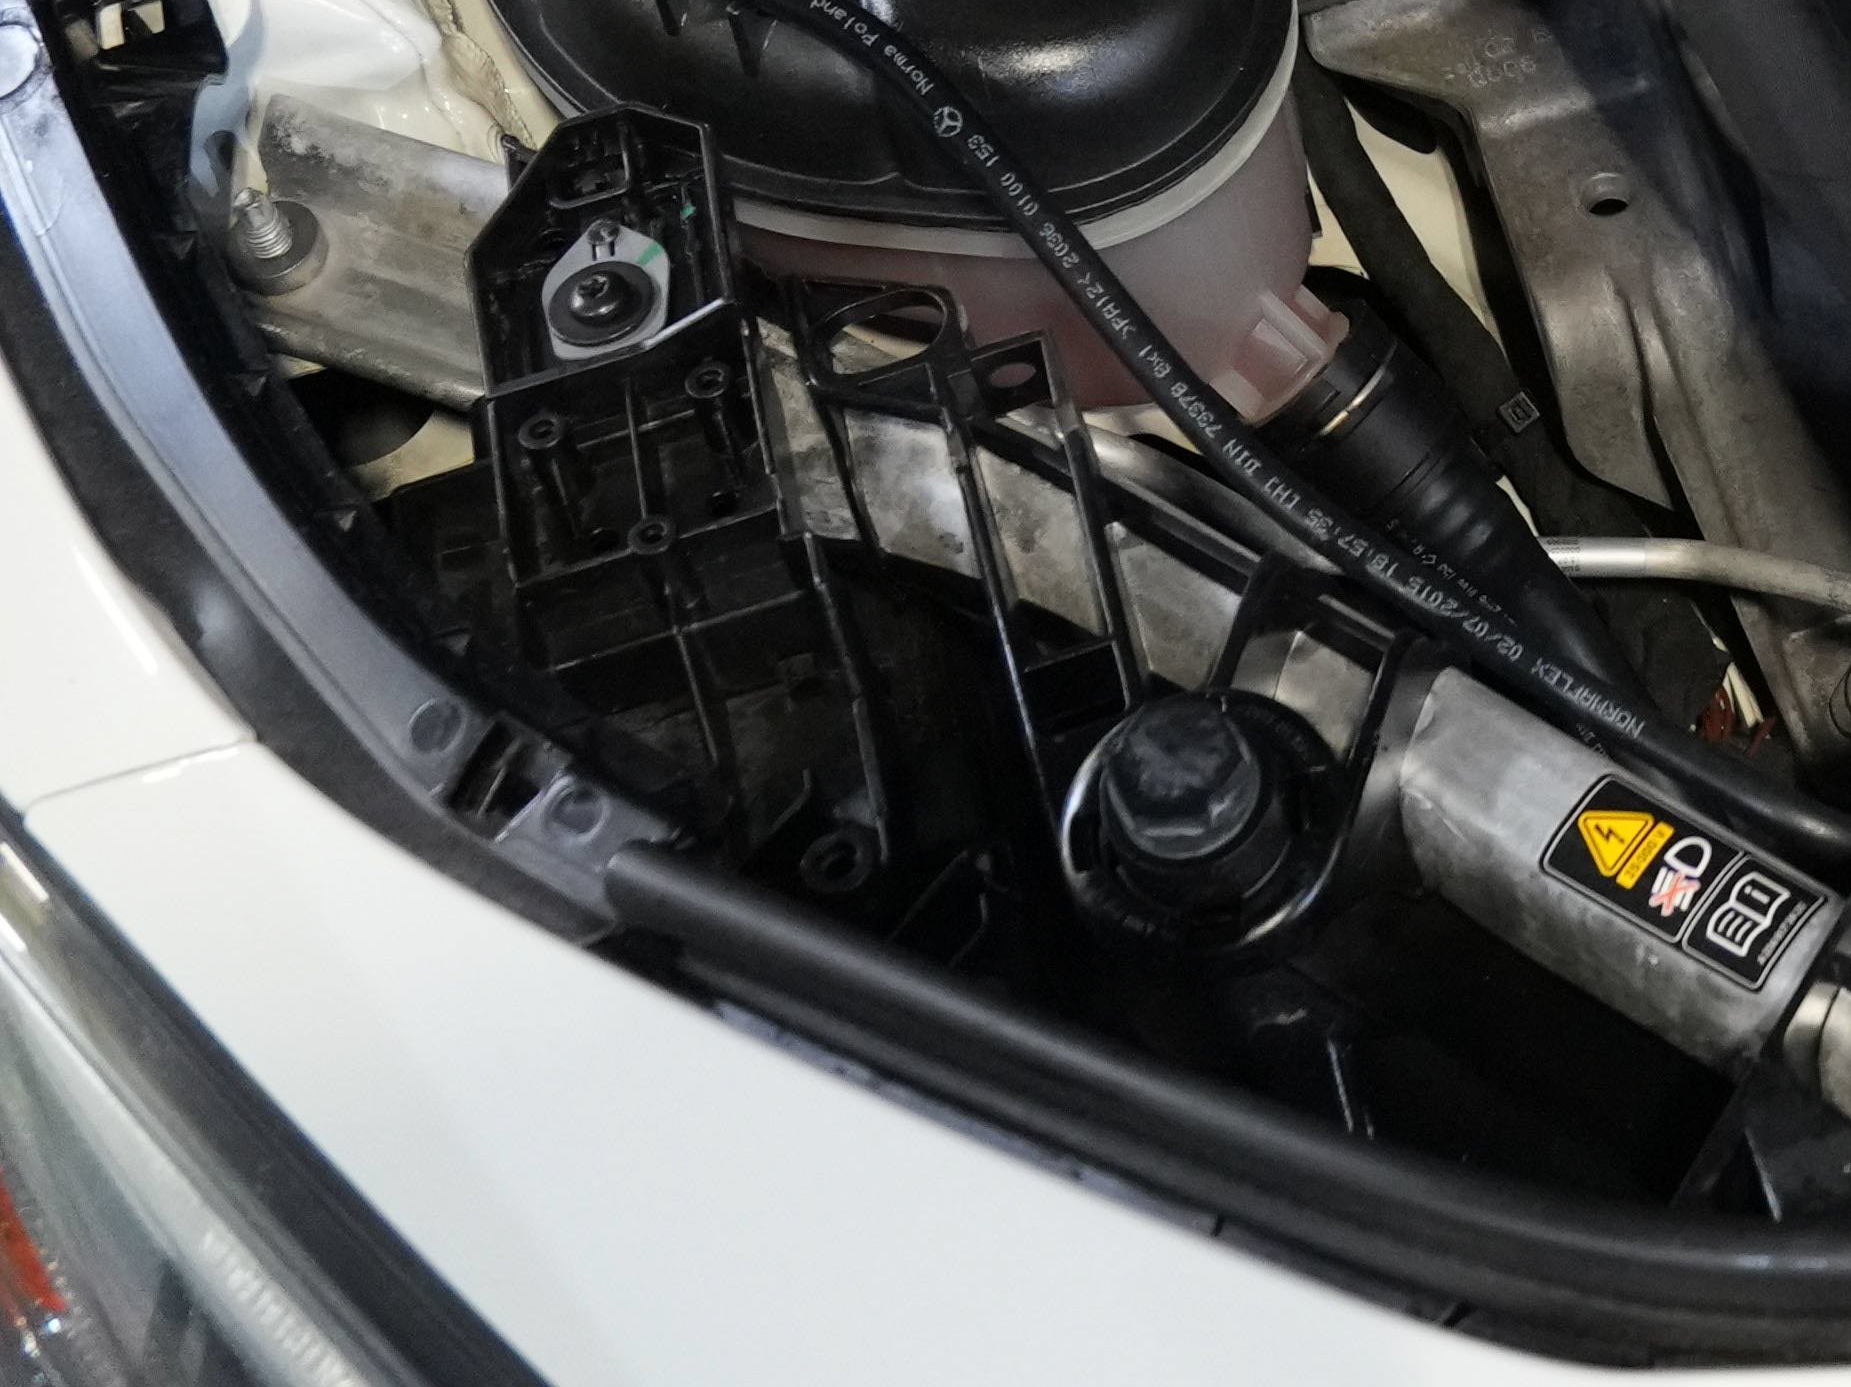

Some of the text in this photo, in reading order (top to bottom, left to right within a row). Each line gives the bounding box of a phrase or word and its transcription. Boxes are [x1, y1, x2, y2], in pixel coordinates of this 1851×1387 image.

[883, 44, 935, 96] Norma
[966, 134, 999, 168] 153
[1001, 171, 1040, 217] 0100
[1170, 381, 1223, 439] 73378
[1222, 438, 1262, 476] DIN
[1406, 576, 1525, 662] 02/07/2015
[1530, 657, 1646, 740] NORMAFLEX
